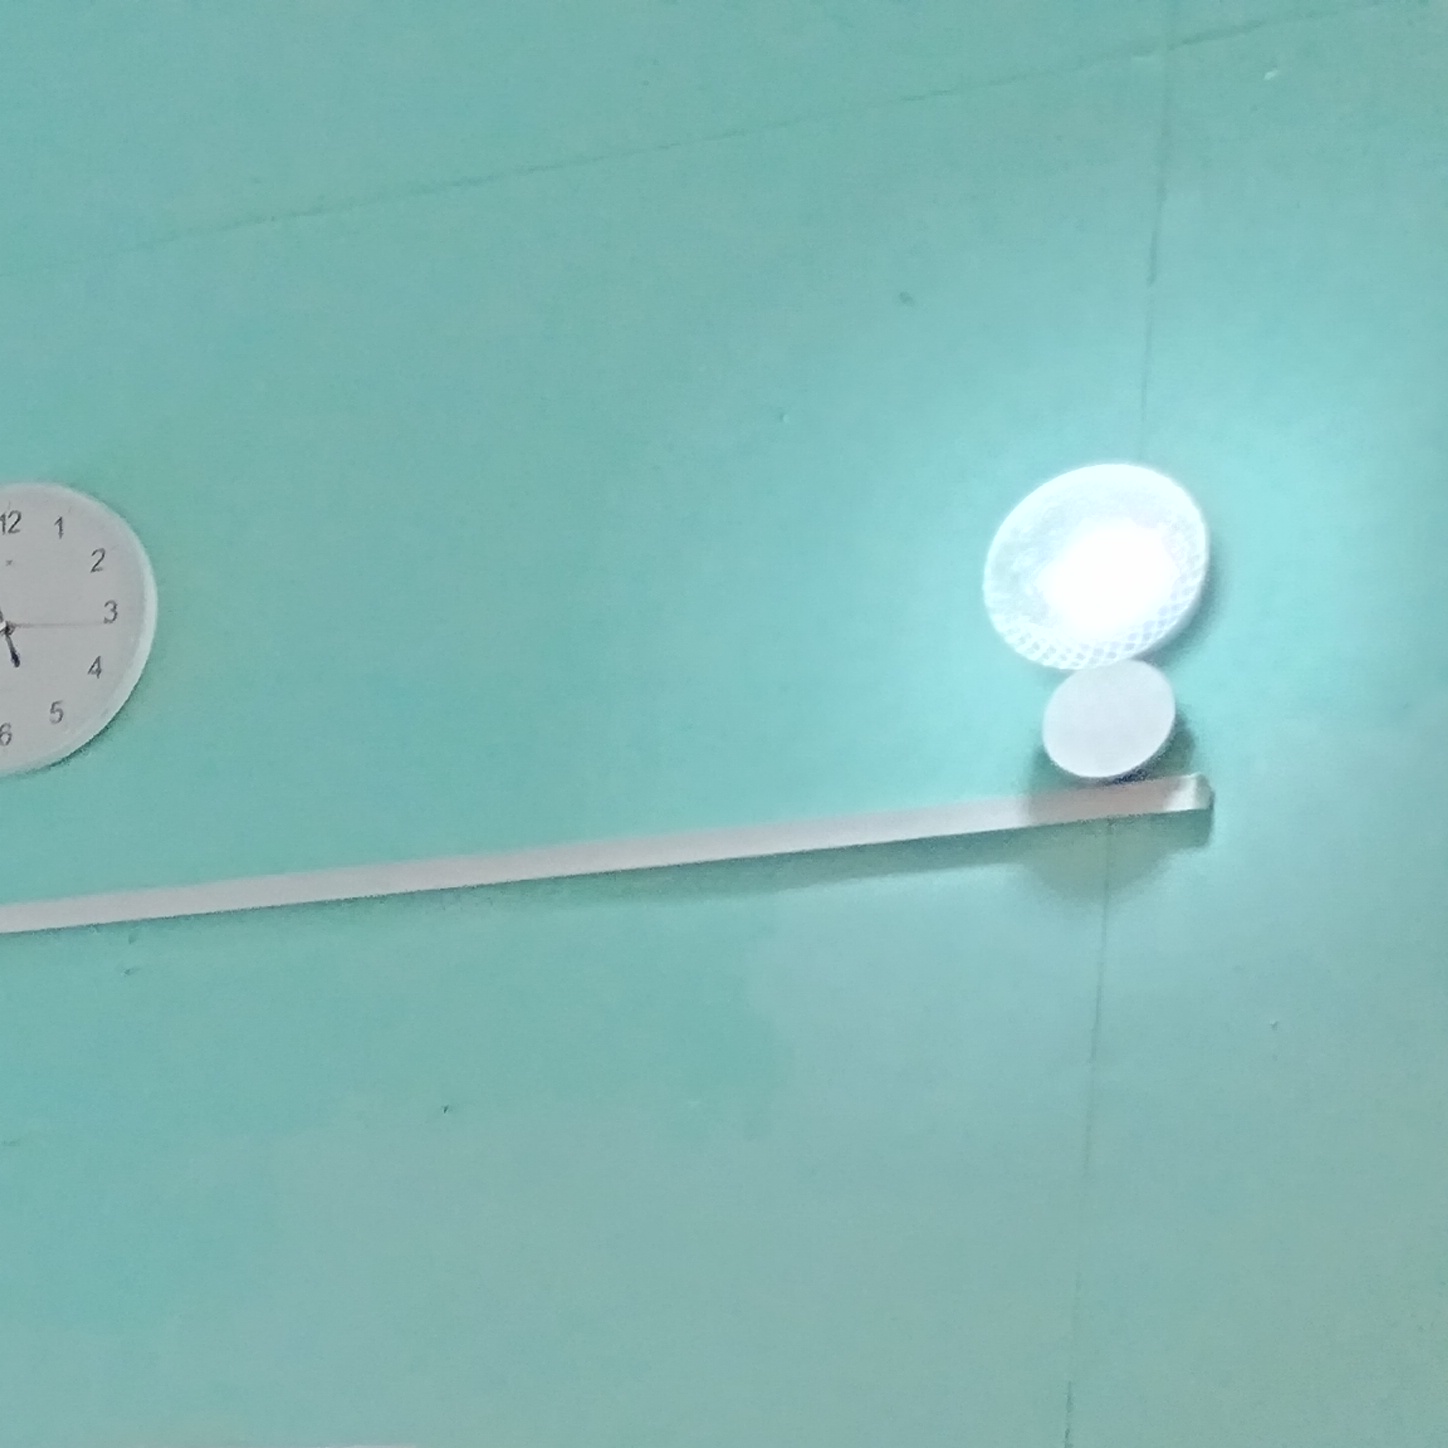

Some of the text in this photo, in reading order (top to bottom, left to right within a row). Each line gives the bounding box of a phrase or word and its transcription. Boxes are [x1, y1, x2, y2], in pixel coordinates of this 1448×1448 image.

[54, 516, 65, 540] 1
[90, 548, 106, 573] 2
[103, 600, 119, 625] 3
[87, 655, 103, 679] 4
[49, 701, 65, 725] 5
